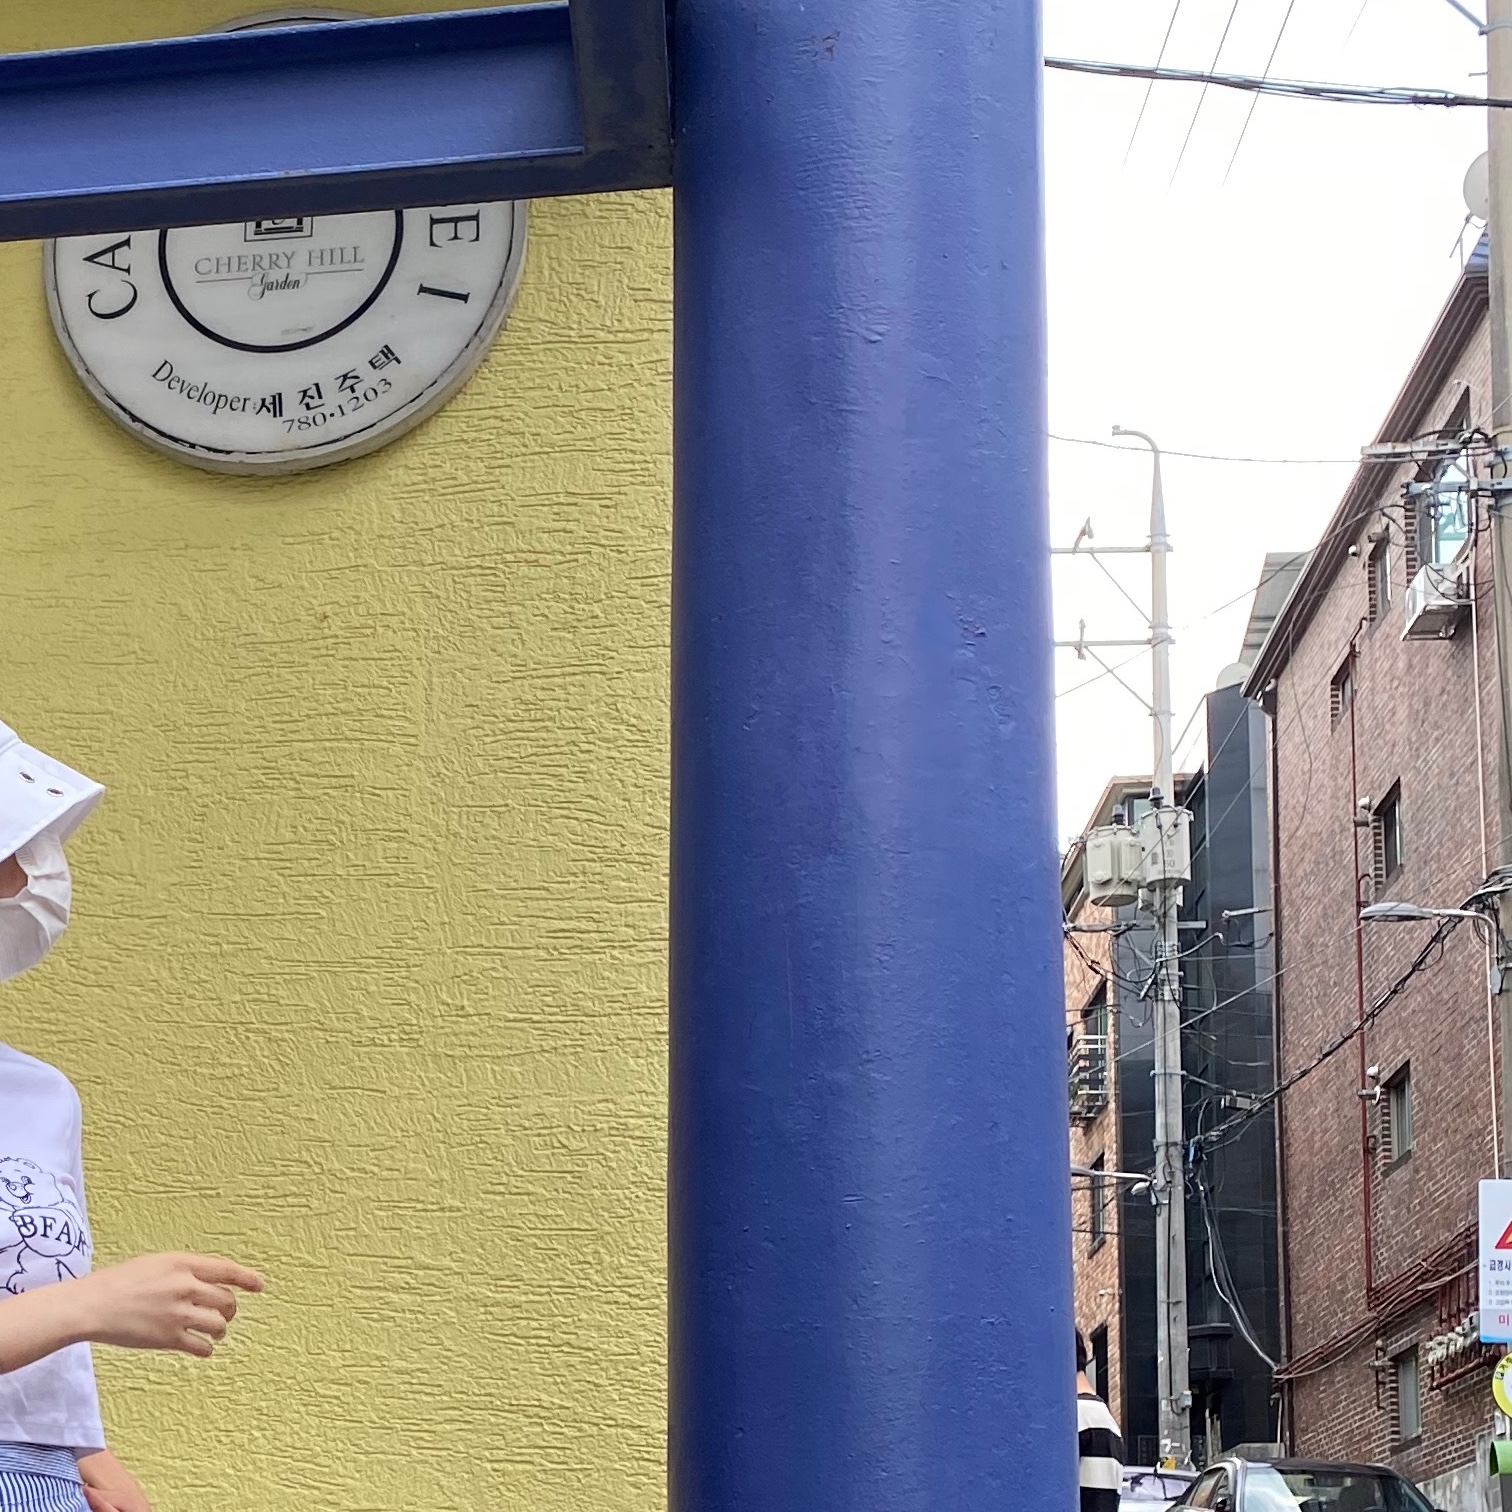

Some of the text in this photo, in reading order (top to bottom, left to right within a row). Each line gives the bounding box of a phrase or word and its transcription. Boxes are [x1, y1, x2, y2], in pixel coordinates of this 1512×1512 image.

[194, 246, 366, 276] CHERRY HILL
[247, 272, 301, 301] Garden
